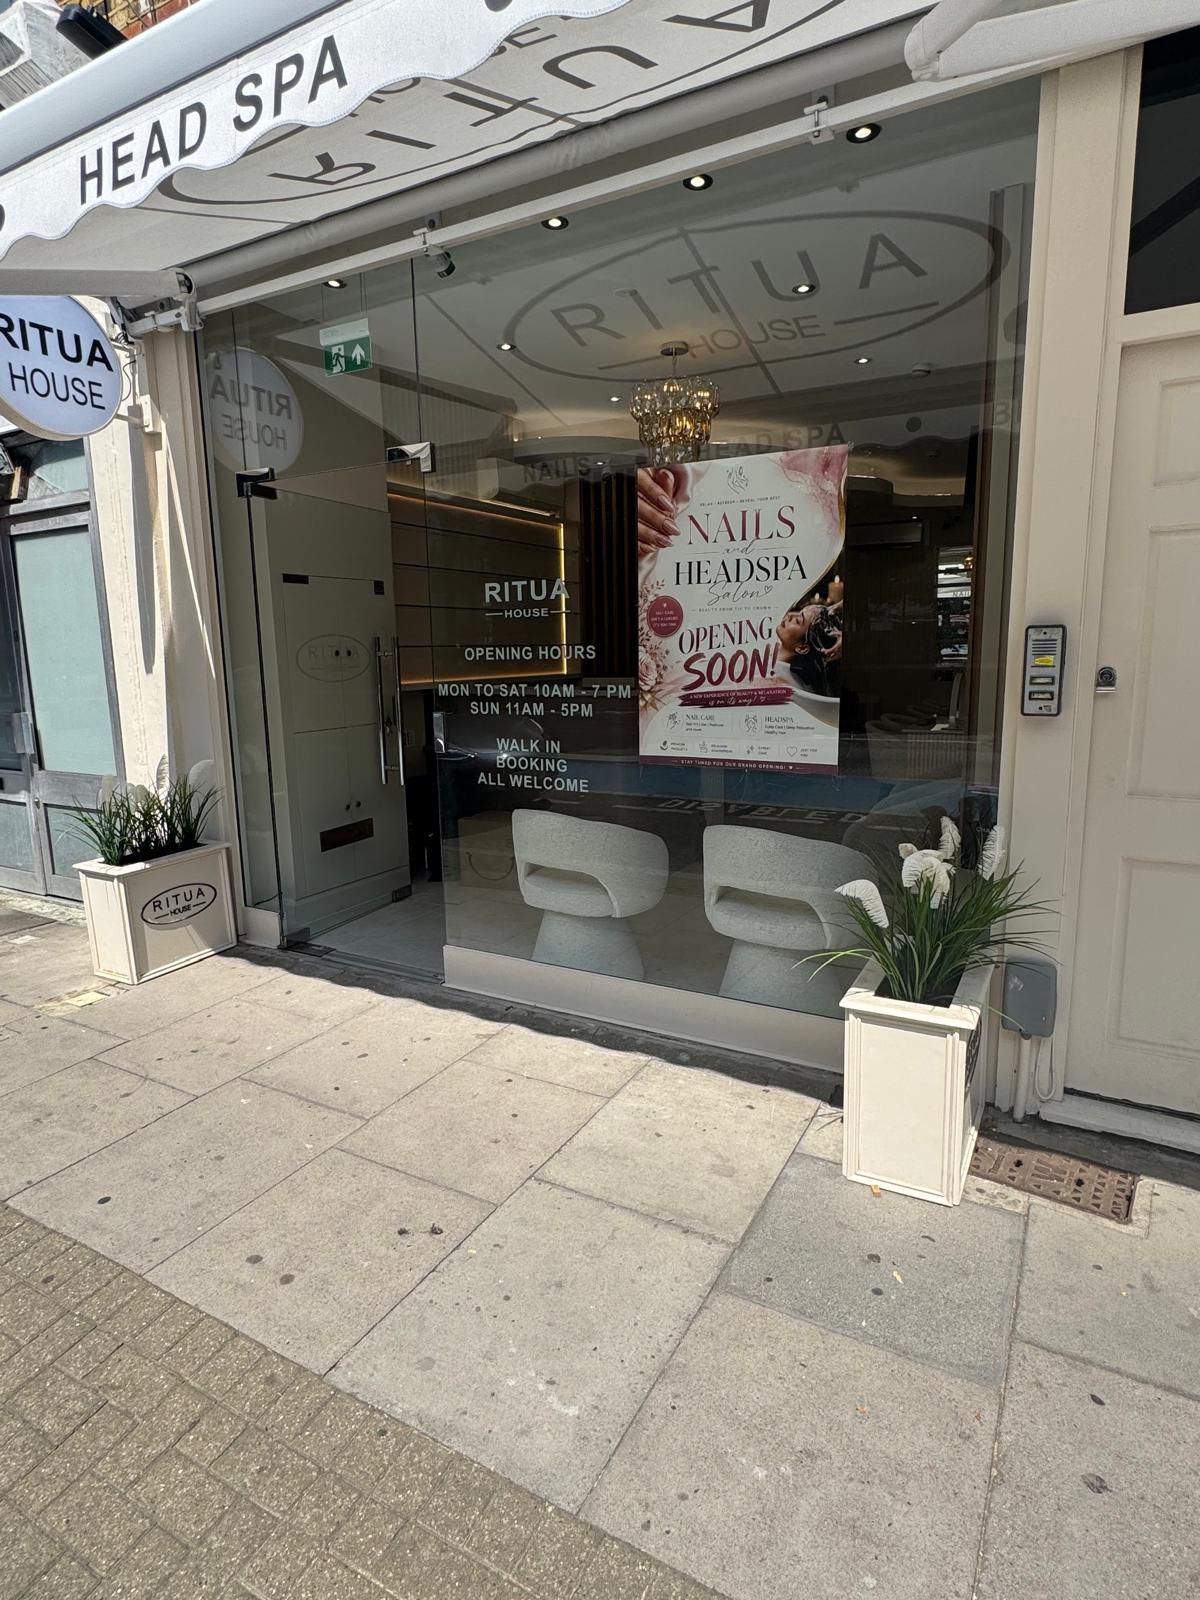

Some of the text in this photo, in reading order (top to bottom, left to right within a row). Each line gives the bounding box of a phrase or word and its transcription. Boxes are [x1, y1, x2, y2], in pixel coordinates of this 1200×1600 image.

[79, 101, 208, 205] HEAD
[232, 35, 349, 132] SPA
[549, 233, 930, 349] RITUA
[0, 312, 114, 373] RITUA
[685, 313, 827, 360] HOUSE
[8, 361, 106, 411] HOUSE
[687, 505, 796, 545] NAILS
[722, 539, 758, 556] and
[674, 553, 808, 586] HEADSPA
[484, 577, 571, 604] RITUA
[707, 580, 763, 607] Salon
[504, 607, 549, 619] HOUSE
[678, 616, 773, 655] OPENING
[464, 645, 597, 661] OPENING HOURS
[681, 642, 781, 692] SOON!
[438, 684, 470, 697] MON
[475, 683, 494, 697] TO
[499, 684, 528, 697] SAT
[533, 684, 575, 698] 10AM
[591, 685, 600, 698] 7
[606, 685, 632, 699] PM
[470, 701, 500, 716] SUN
[505, 702, 545, 716] 11AM
[560, 703, 593, 717] 5PM
[496, 737, 561, 754] WALK IN
[496, 756, 568, 773] BOOKING
[477, 772, 590, 793] ALL WELCOME
[152, 888, 206, 912] RITUA
[169, 904, 192, 917] HOUSE
